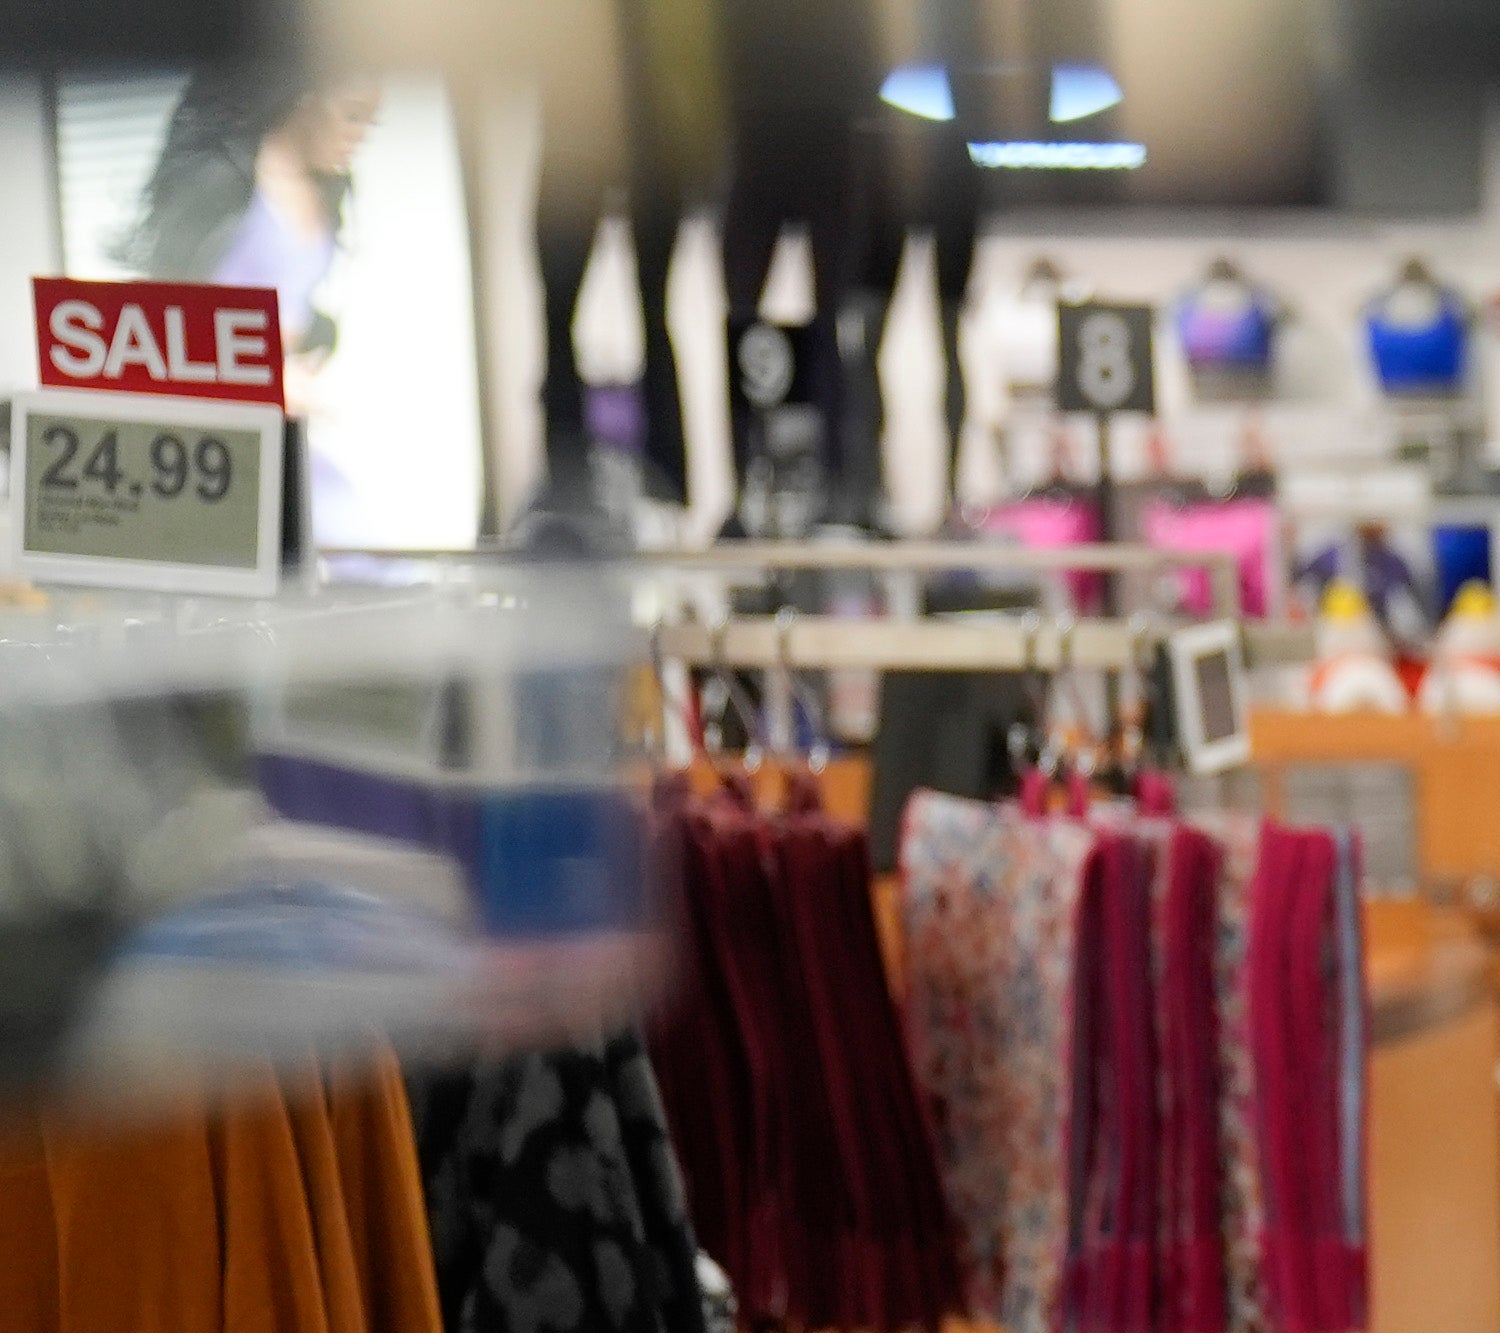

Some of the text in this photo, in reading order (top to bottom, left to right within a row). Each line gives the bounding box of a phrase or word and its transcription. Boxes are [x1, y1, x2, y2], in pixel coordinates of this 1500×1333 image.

[48, 300, 274, 386] SALE
[1075, 310, 1137, 405] 8
[41, 424, 234, 504] 24.99
